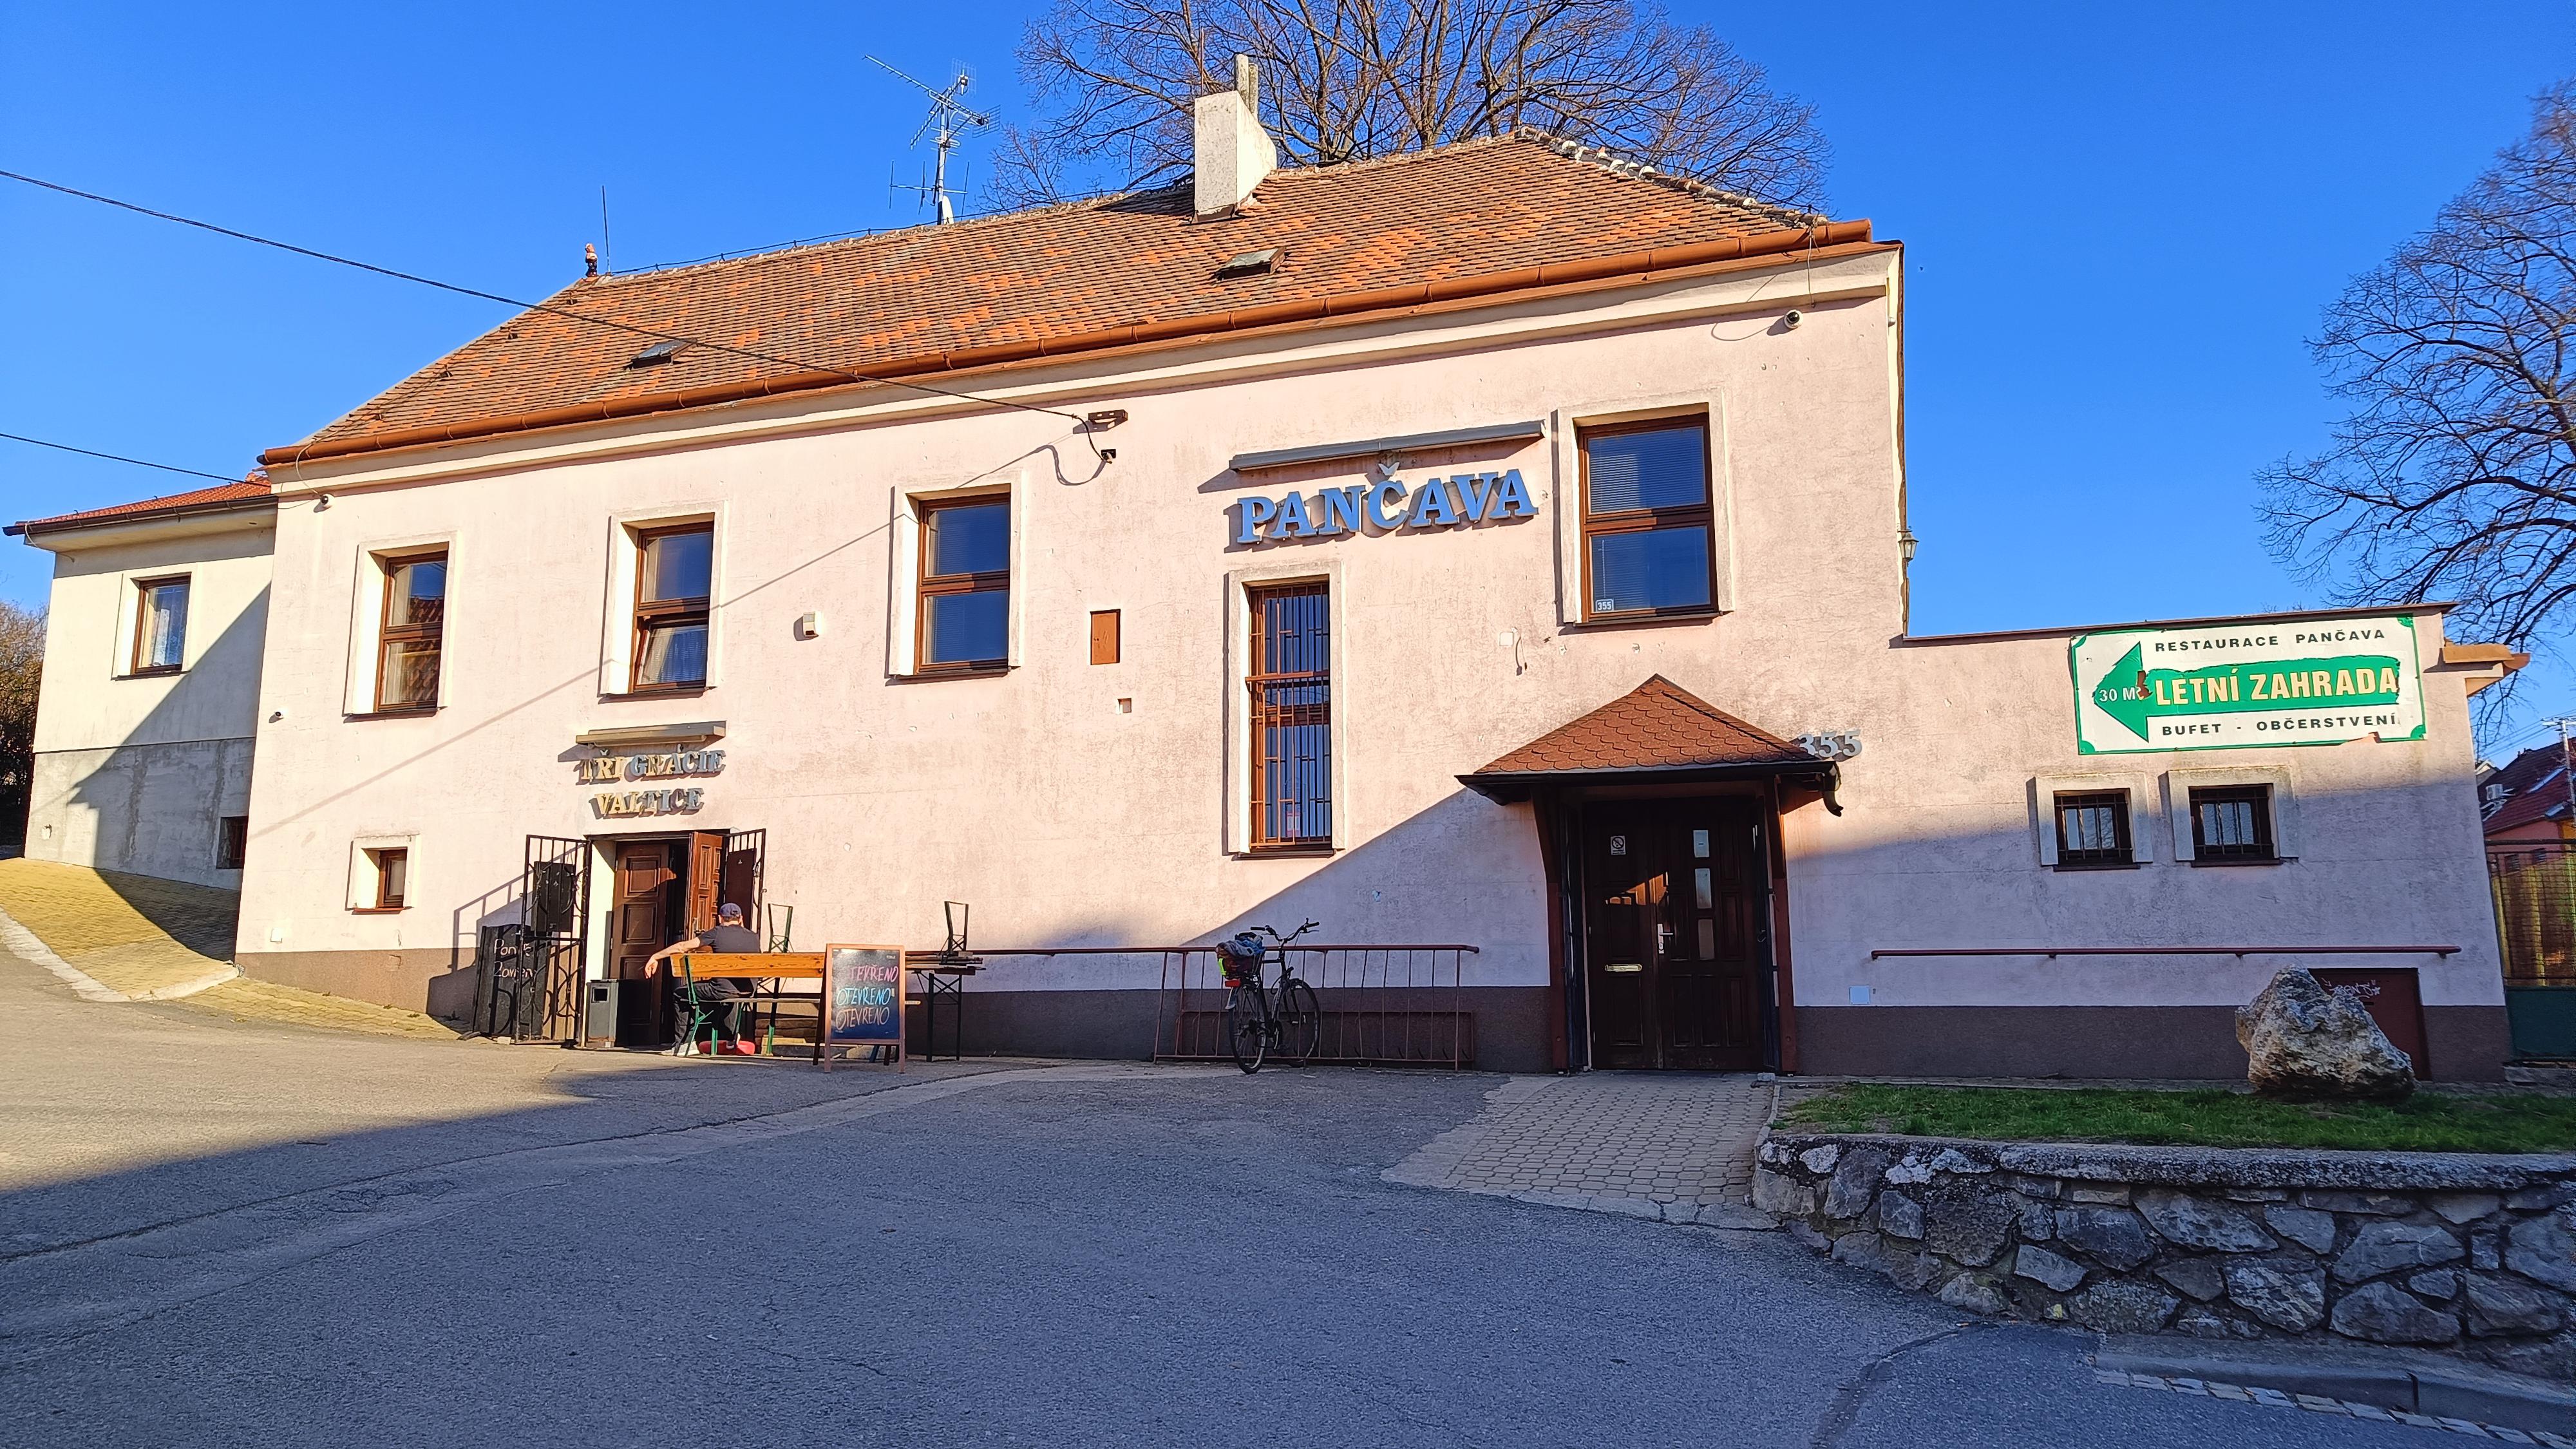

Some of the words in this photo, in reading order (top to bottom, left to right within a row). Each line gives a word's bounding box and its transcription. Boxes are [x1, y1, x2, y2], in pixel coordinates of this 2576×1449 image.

[1236, 462, 1539, 544] PANČAVA
[1598, 601, 1612, 611] 355
[2155, 635, 2280, 652] RESTAURACE
[2295, 628, 2386, 645] PANČAVA
[2099, 688, 2118, 702] 30
[2155, 667, 2240, 706] LETNÍ
[2249, 667, 2398, 702] ZAHRADA
[2162, 723, 2222, 736] BUFET
[2256, 714, 2396, 732] OBČERSTVENÍ
[1797, 729, 1862, 758] 355
[594, 788, 705, 817] VALTICE
[849, 964, 898, 983] TEVŘENO
